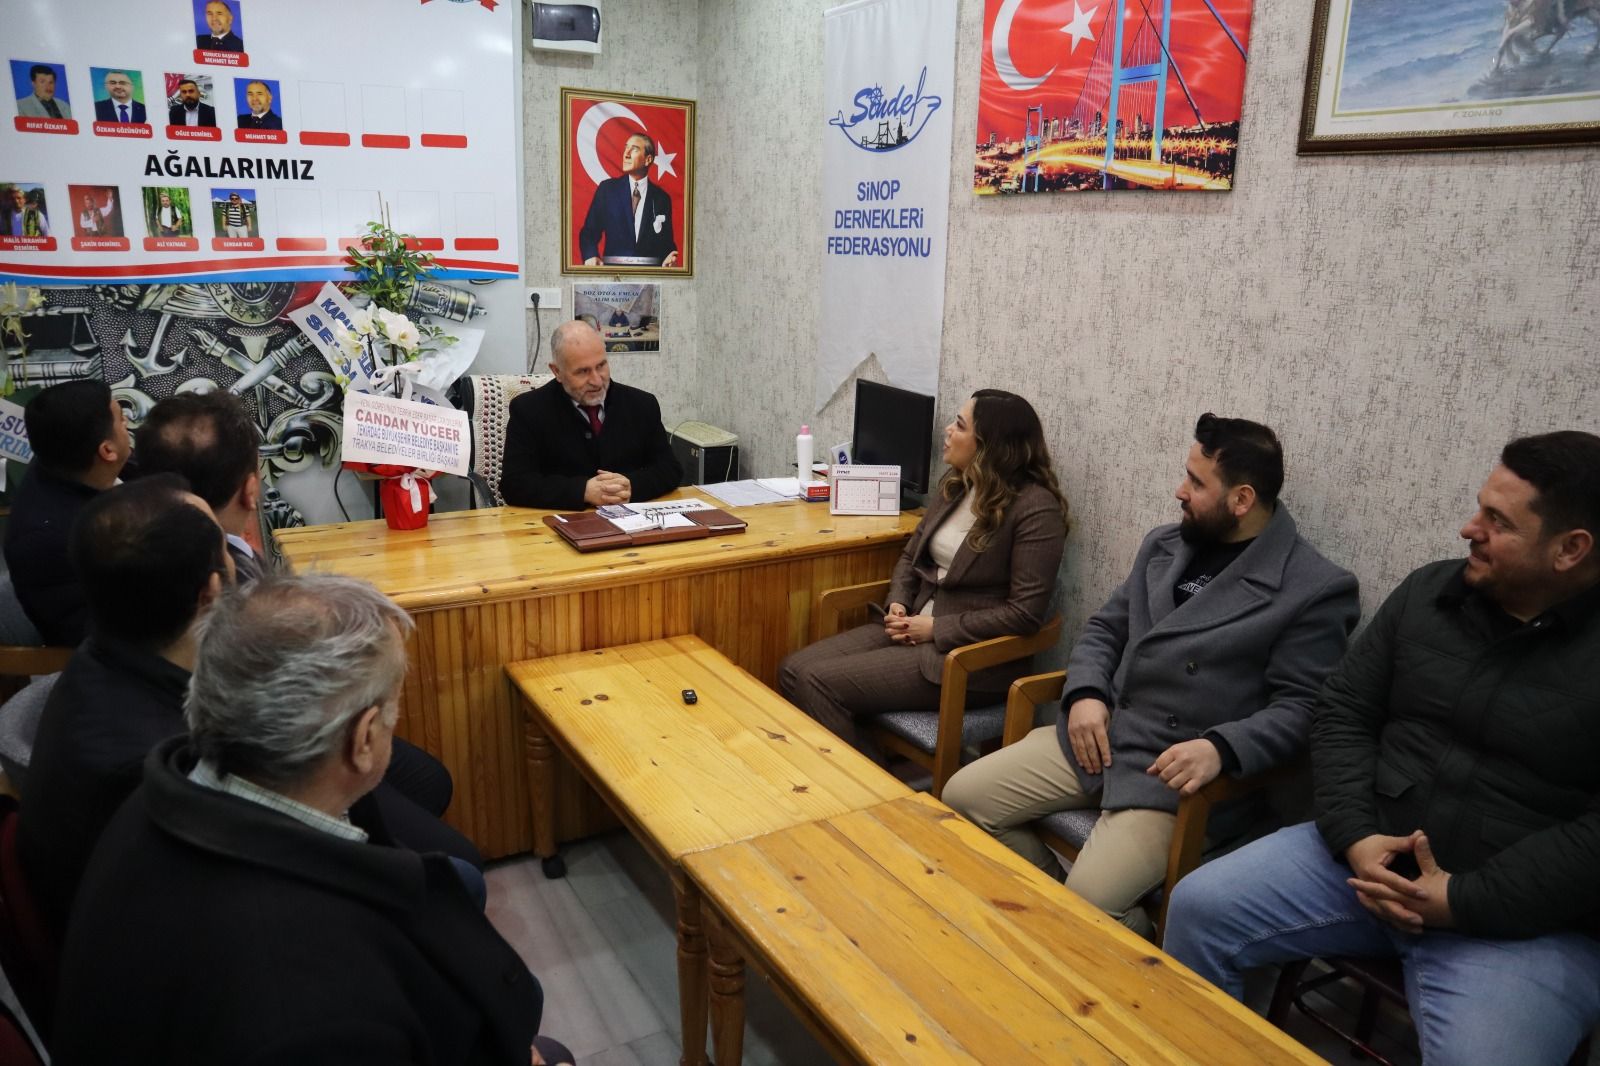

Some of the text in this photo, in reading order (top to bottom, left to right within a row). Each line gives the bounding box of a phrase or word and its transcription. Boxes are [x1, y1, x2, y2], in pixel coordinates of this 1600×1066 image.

[1462, 108, 1503, 118] ZONARO
[43, 121, 68, 131] ÖZKAYA
[95, 125, 116, 133] ÖZKAN
[144, 149, 315, 181] AĞALARIMIZ
[827, 236, 931, 258] FEDERASYONU
[355, 408, 409, 432] CANDAN
[352, 437, 377, 450] TRAKYA
